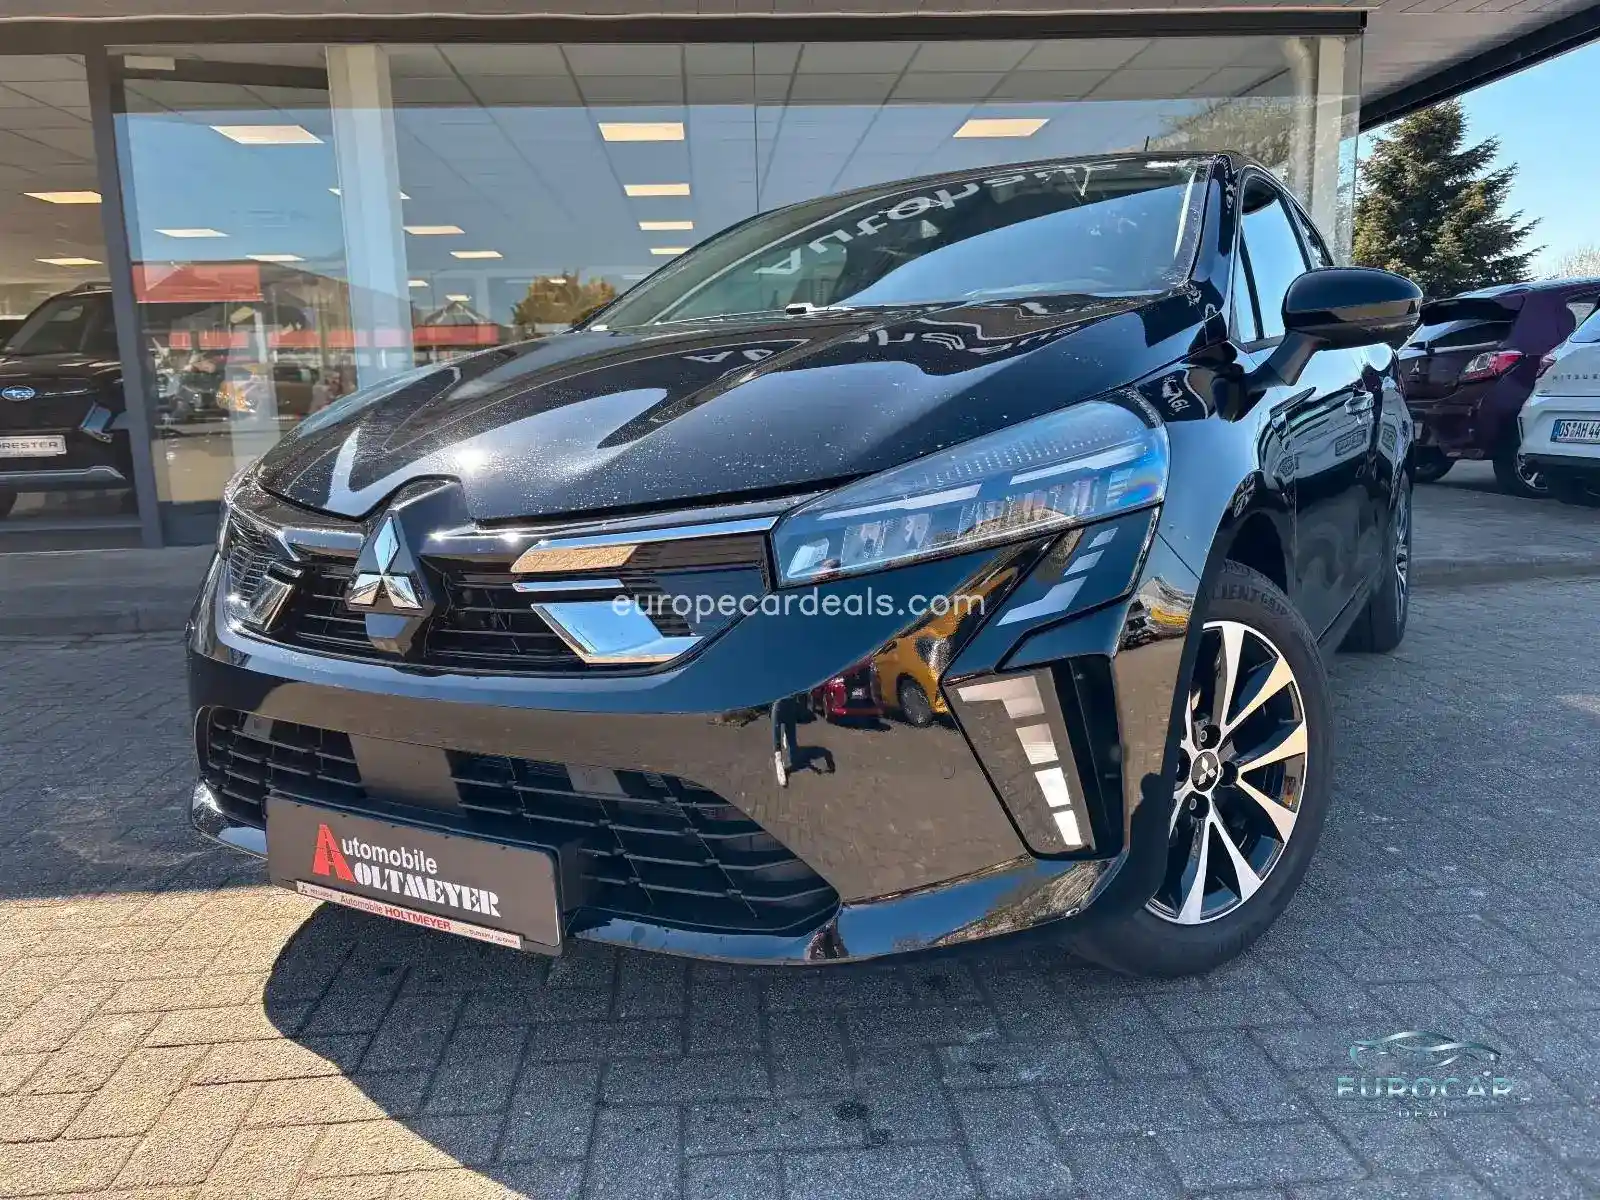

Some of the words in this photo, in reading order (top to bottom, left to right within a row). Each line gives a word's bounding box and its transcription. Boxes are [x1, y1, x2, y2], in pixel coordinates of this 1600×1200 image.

[312, 823, 438, 884] Automobile
[340, 895, 384, 914] Automobile
[384, 906, 452, 931] HOLTMEYER
